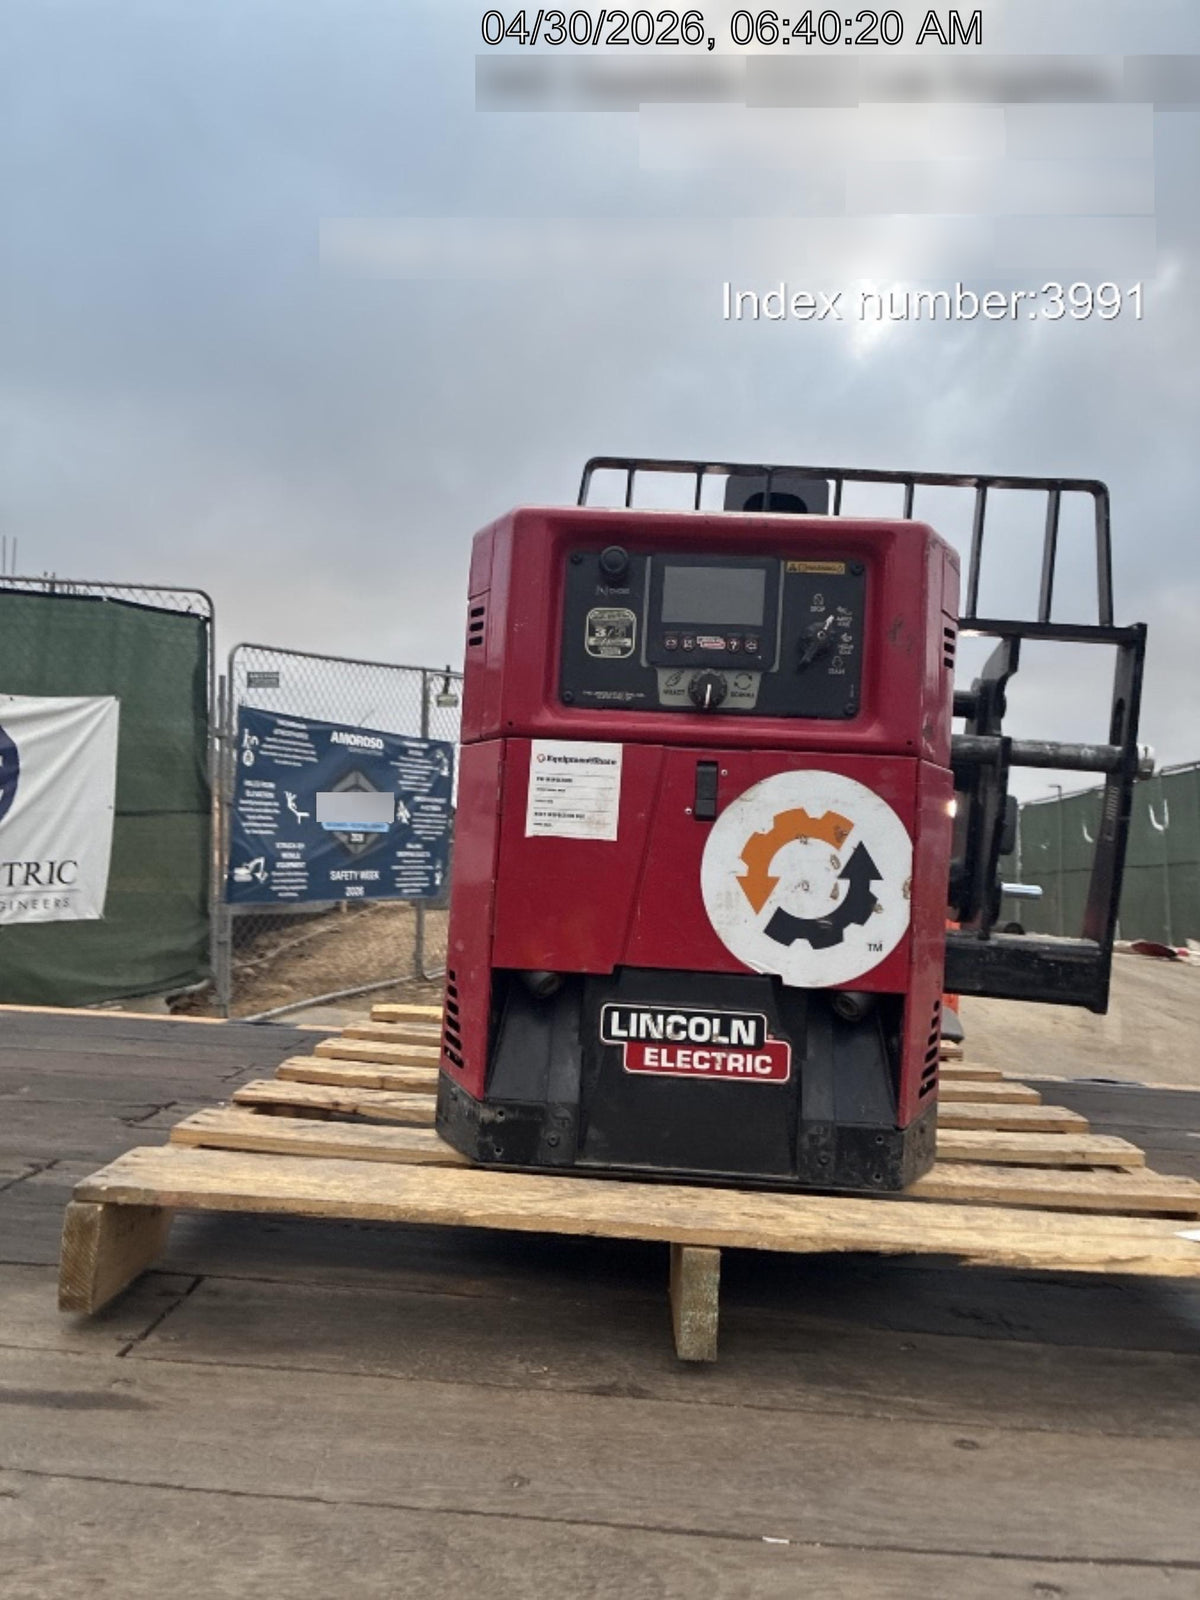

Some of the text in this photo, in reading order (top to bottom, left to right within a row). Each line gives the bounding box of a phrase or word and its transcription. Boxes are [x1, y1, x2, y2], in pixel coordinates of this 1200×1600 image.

[330, 730, 385, 750] AMOROSO
[2, 860, 78, 887] TRIC
[329, 870, 358, 881] SAFETY
[867, 943, 883, 952] TM
[610, 1011, 757, 1046] LINCOLN
[643, 1047, 773, 1075] ELECTRIC
